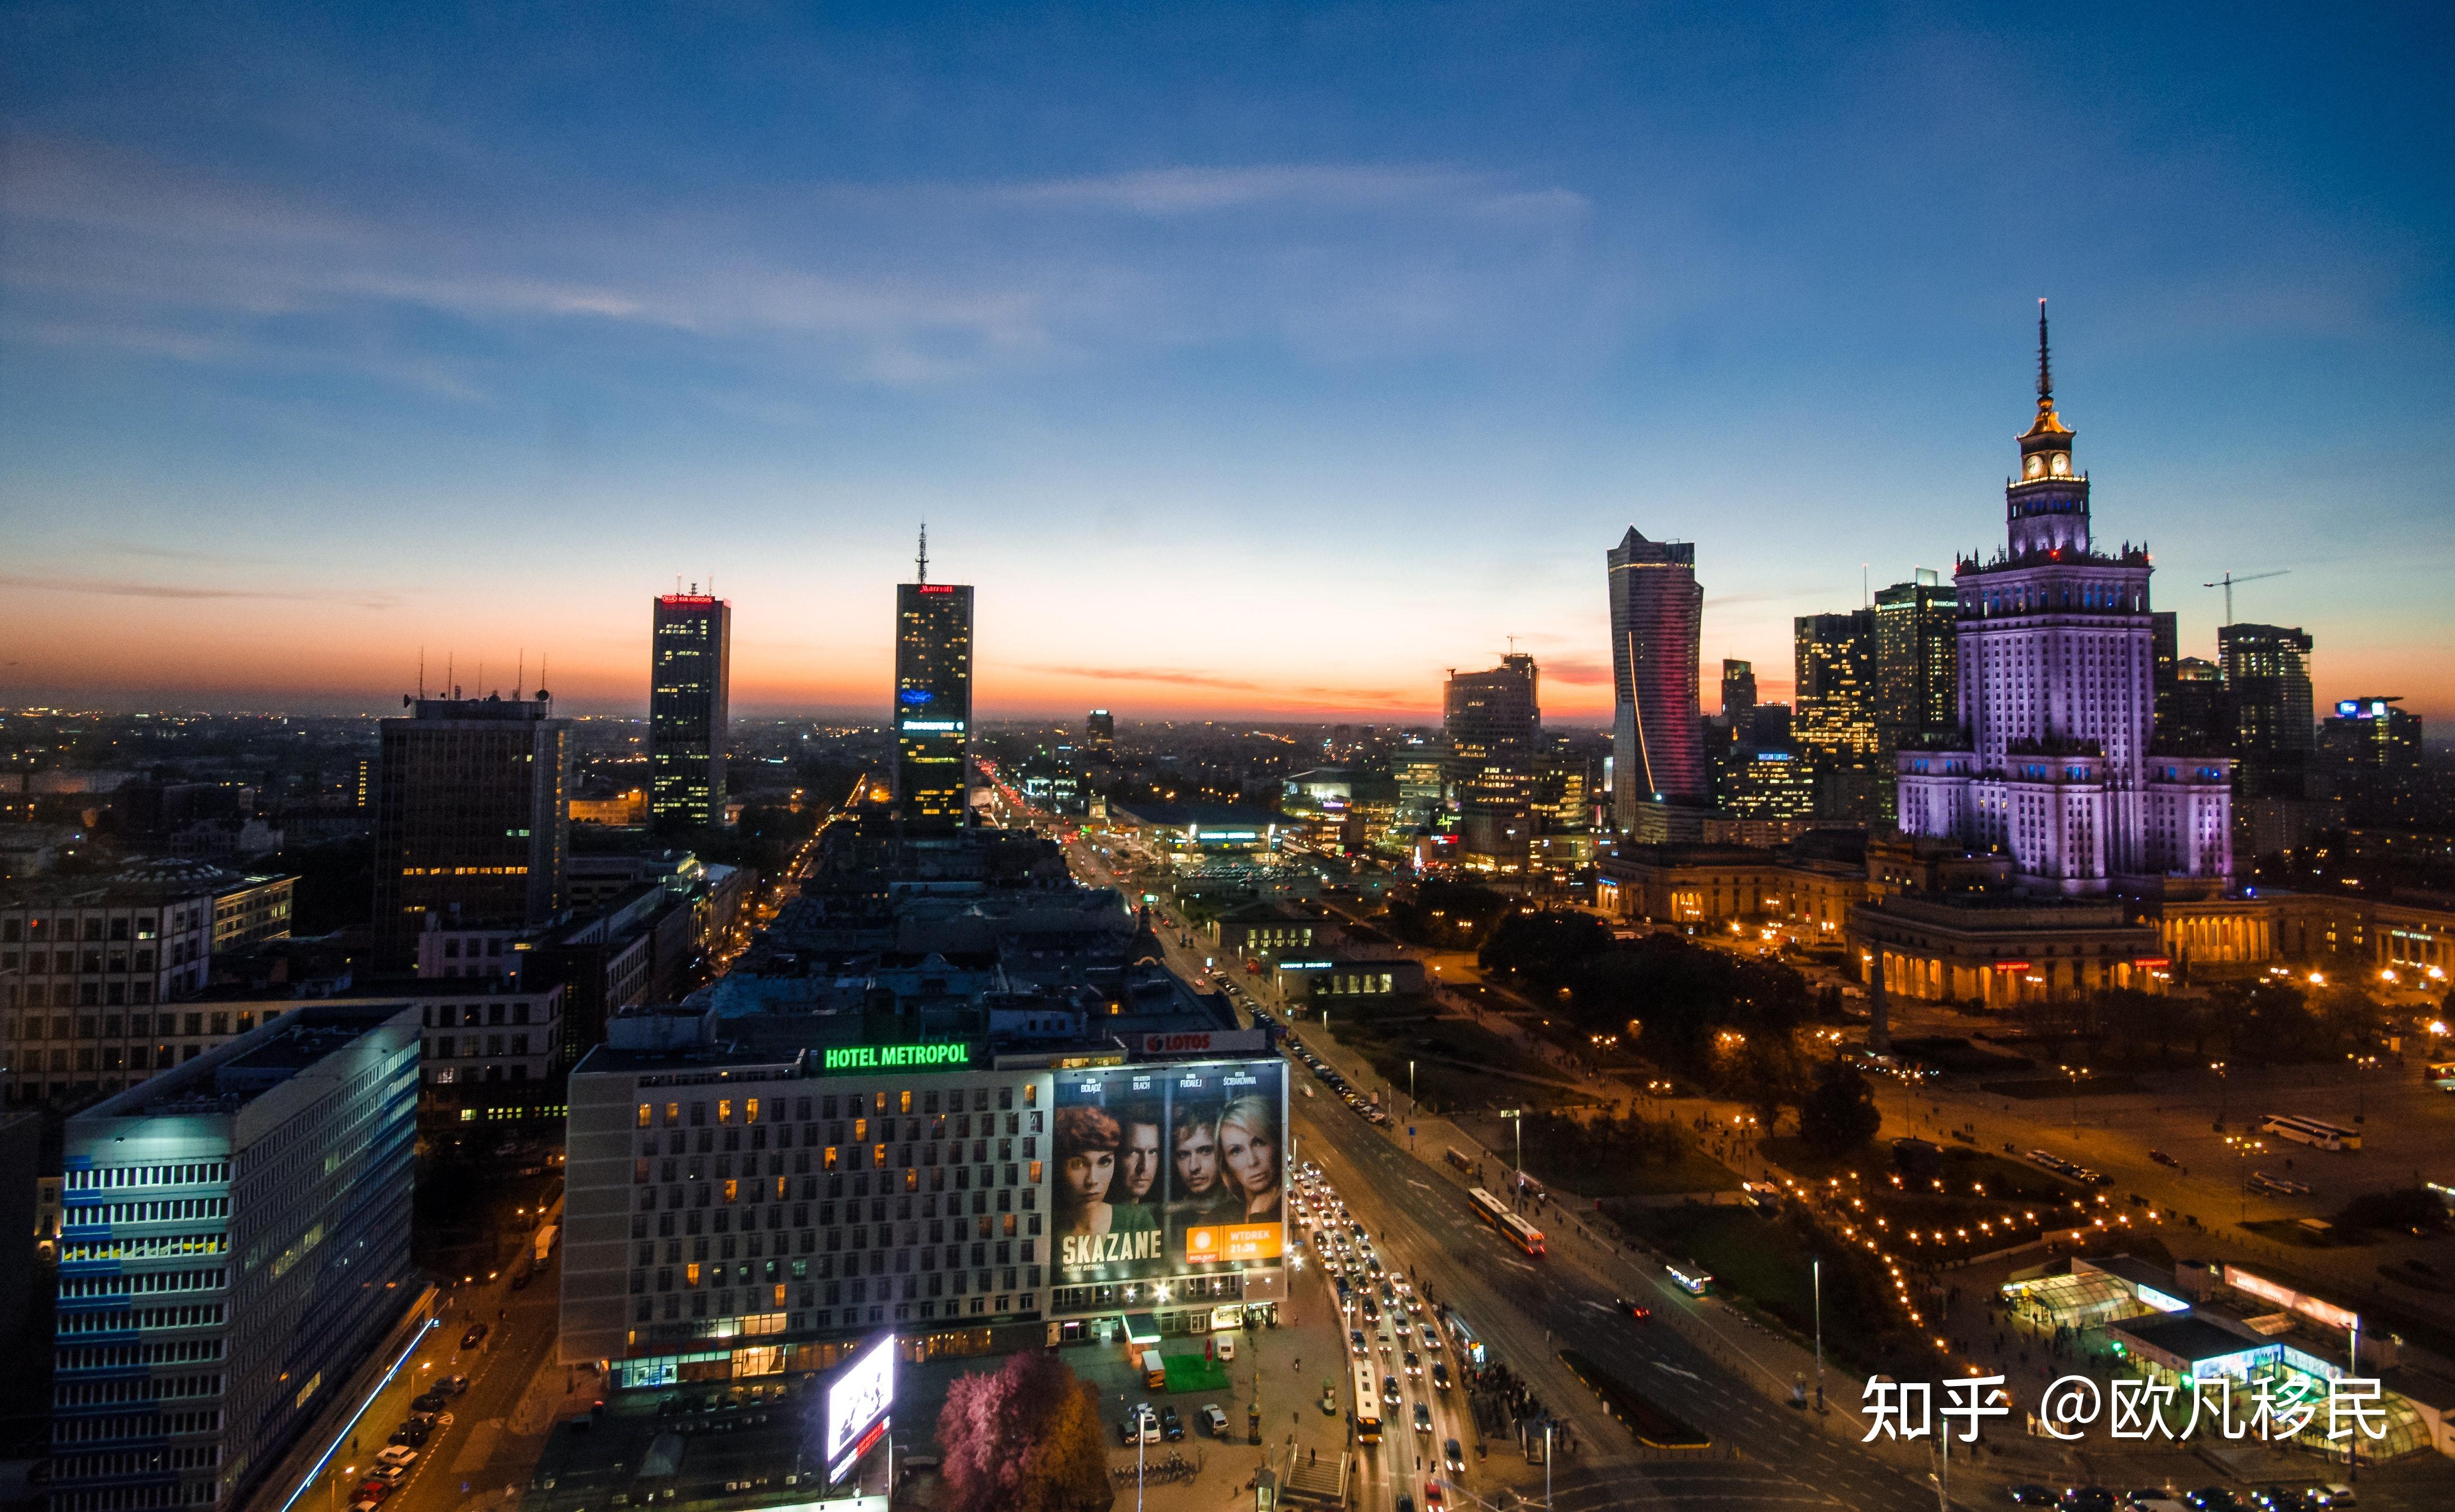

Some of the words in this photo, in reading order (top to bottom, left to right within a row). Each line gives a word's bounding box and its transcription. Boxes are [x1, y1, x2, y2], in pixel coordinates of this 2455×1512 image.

[1165, 1033, 1210, 1051] LOTOS
[826, 1048, 878, 1068] HOTEL
[881, 1044, 969, 1065] METROPOL
[1230, 1230, 1270, 1241] WTOREK
[1063, 1230, 1162, 1264] SKAZANE
